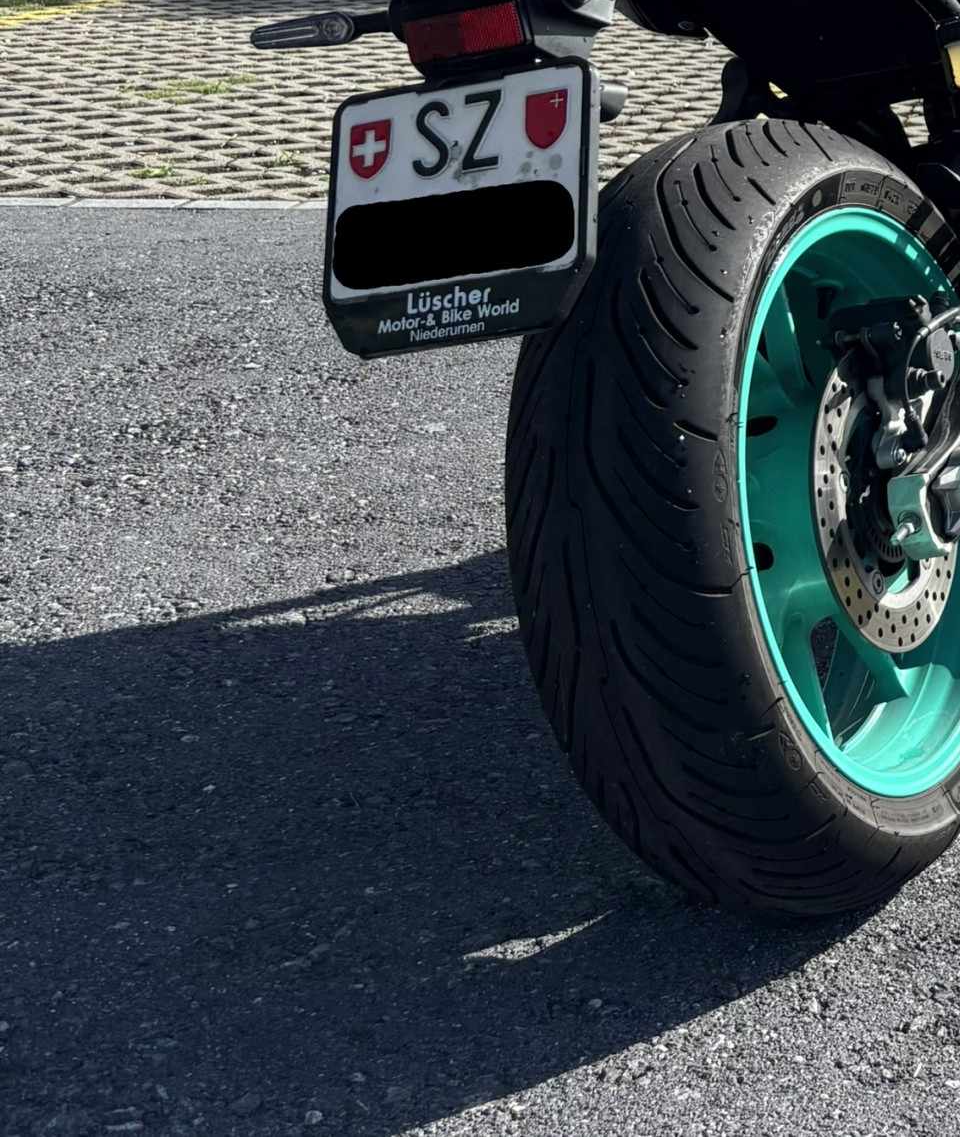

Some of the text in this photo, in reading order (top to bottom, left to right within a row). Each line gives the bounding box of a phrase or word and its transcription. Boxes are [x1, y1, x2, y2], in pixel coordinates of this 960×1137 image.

[412, 89, 502, 177] SZ
[406, 286, 492, 315] Lüscher
[441, 308, 473, 324] Bike
[478, 298, 520, 318] World
